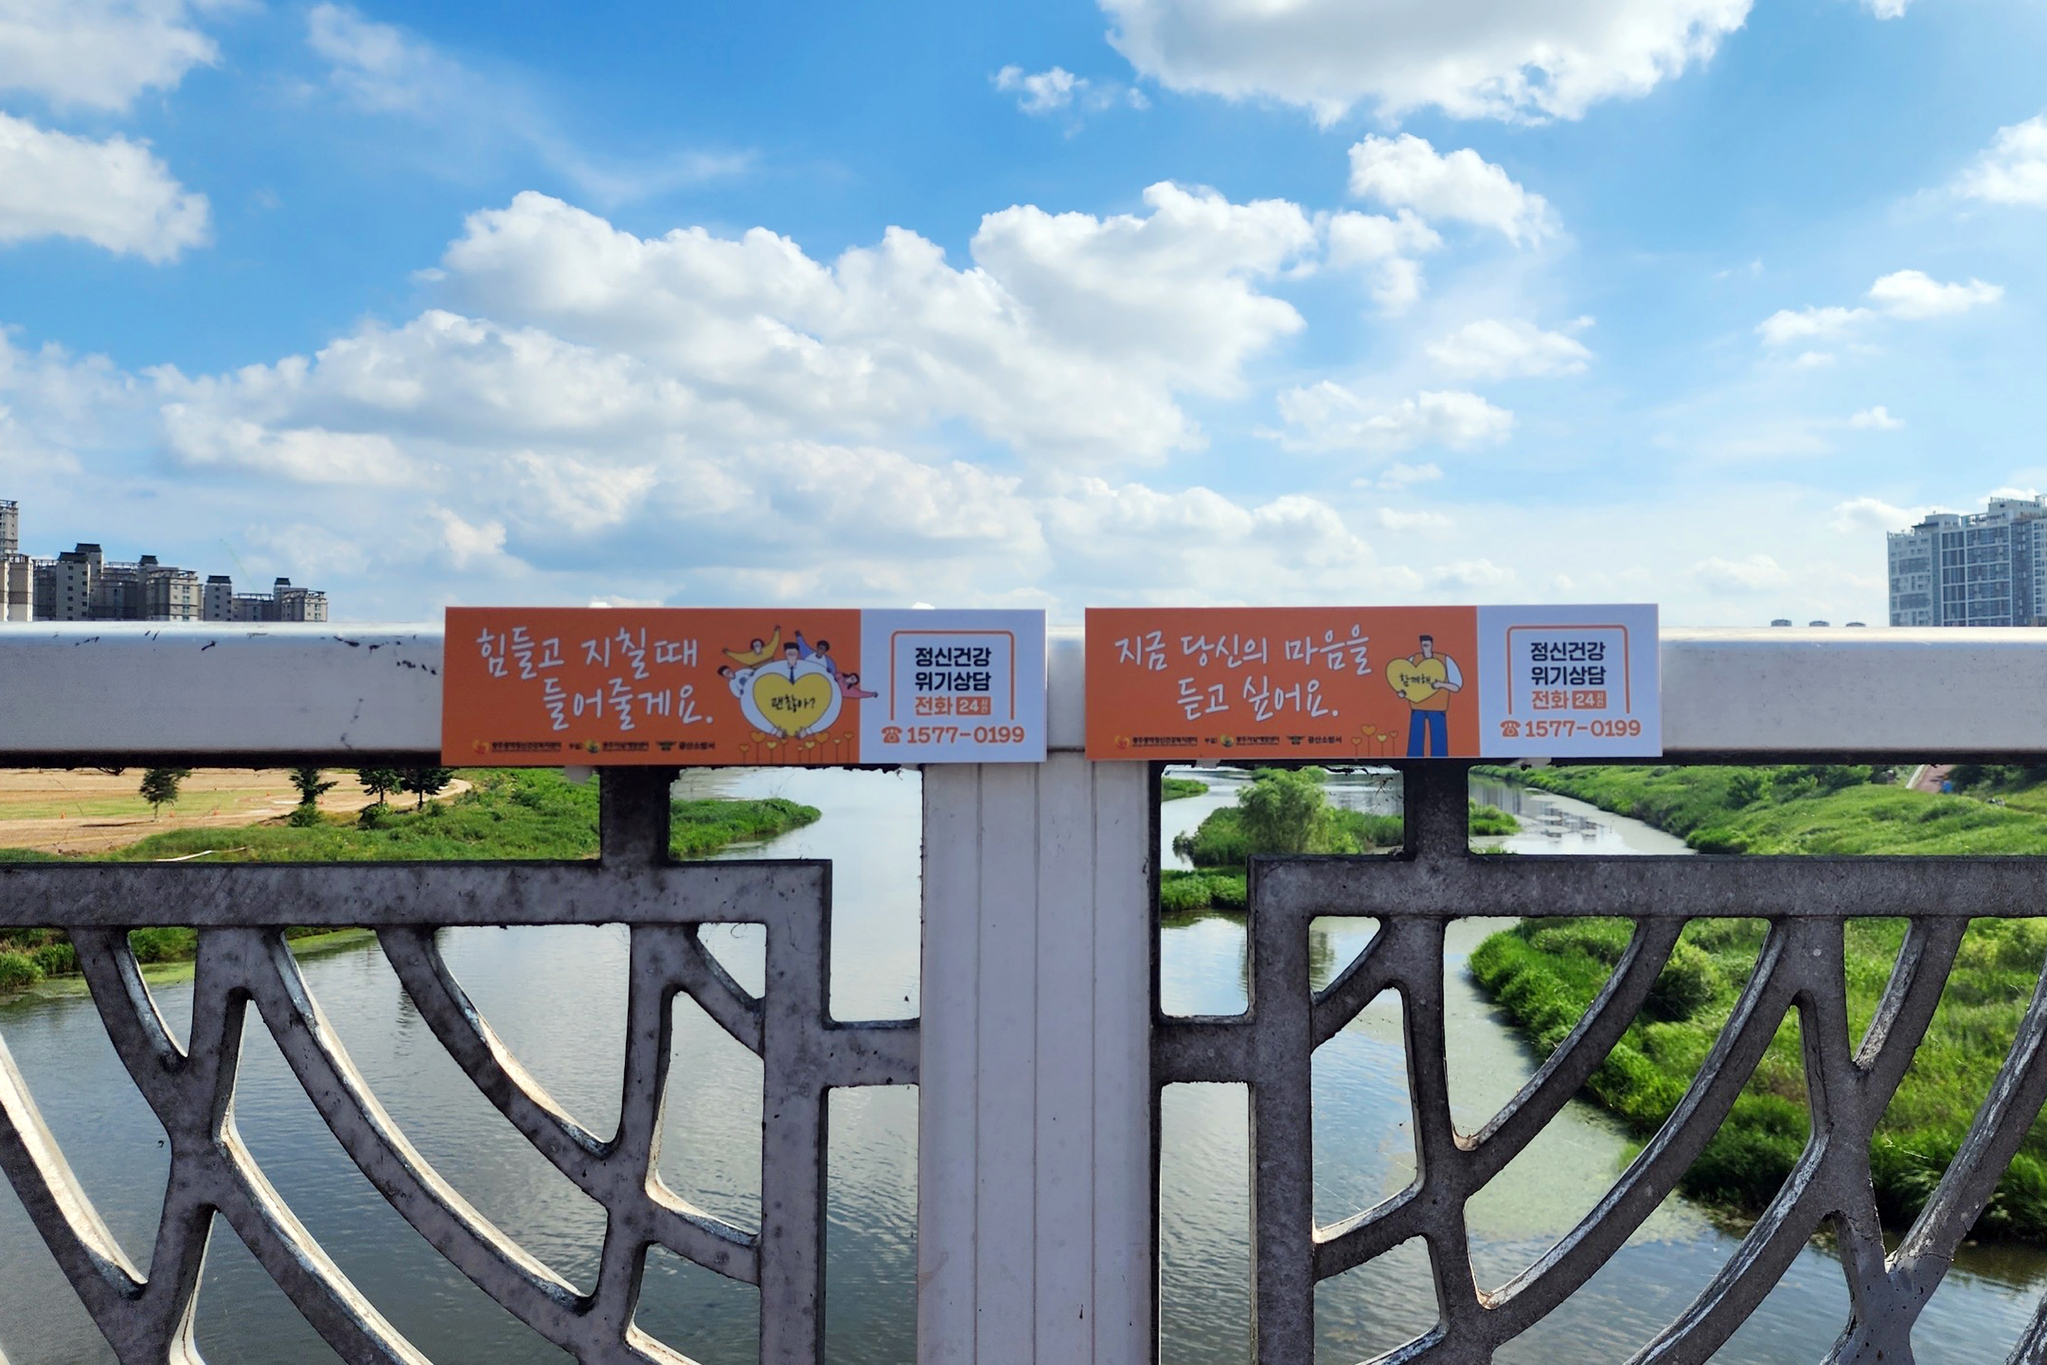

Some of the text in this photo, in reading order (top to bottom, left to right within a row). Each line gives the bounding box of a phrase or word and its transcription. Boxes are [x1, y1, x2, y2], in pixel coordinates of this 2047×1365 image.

[476, 626, 565, 680] 힘들고
[914, 646, 992, 668] 정신건강
[1115, 623, 1373, 676] 지금 당신의 마음을
[1530, 641, 1606, 662] 정신건강
[914, 671, 990, 692] 위기상담
[1531, 665, 1606, 686] 위기상담
[543, 676, 714, 732] 들어줄게요.
[914, 696, 953, 716] 전화
[1177, 675, 1339, 722] 듣고 싶어요.
[1531, 690, 1569, 710] 전화
[907, 725, 1025, 744] 1577-0199
[1525, 719, 1642, 738] 1577-0199
